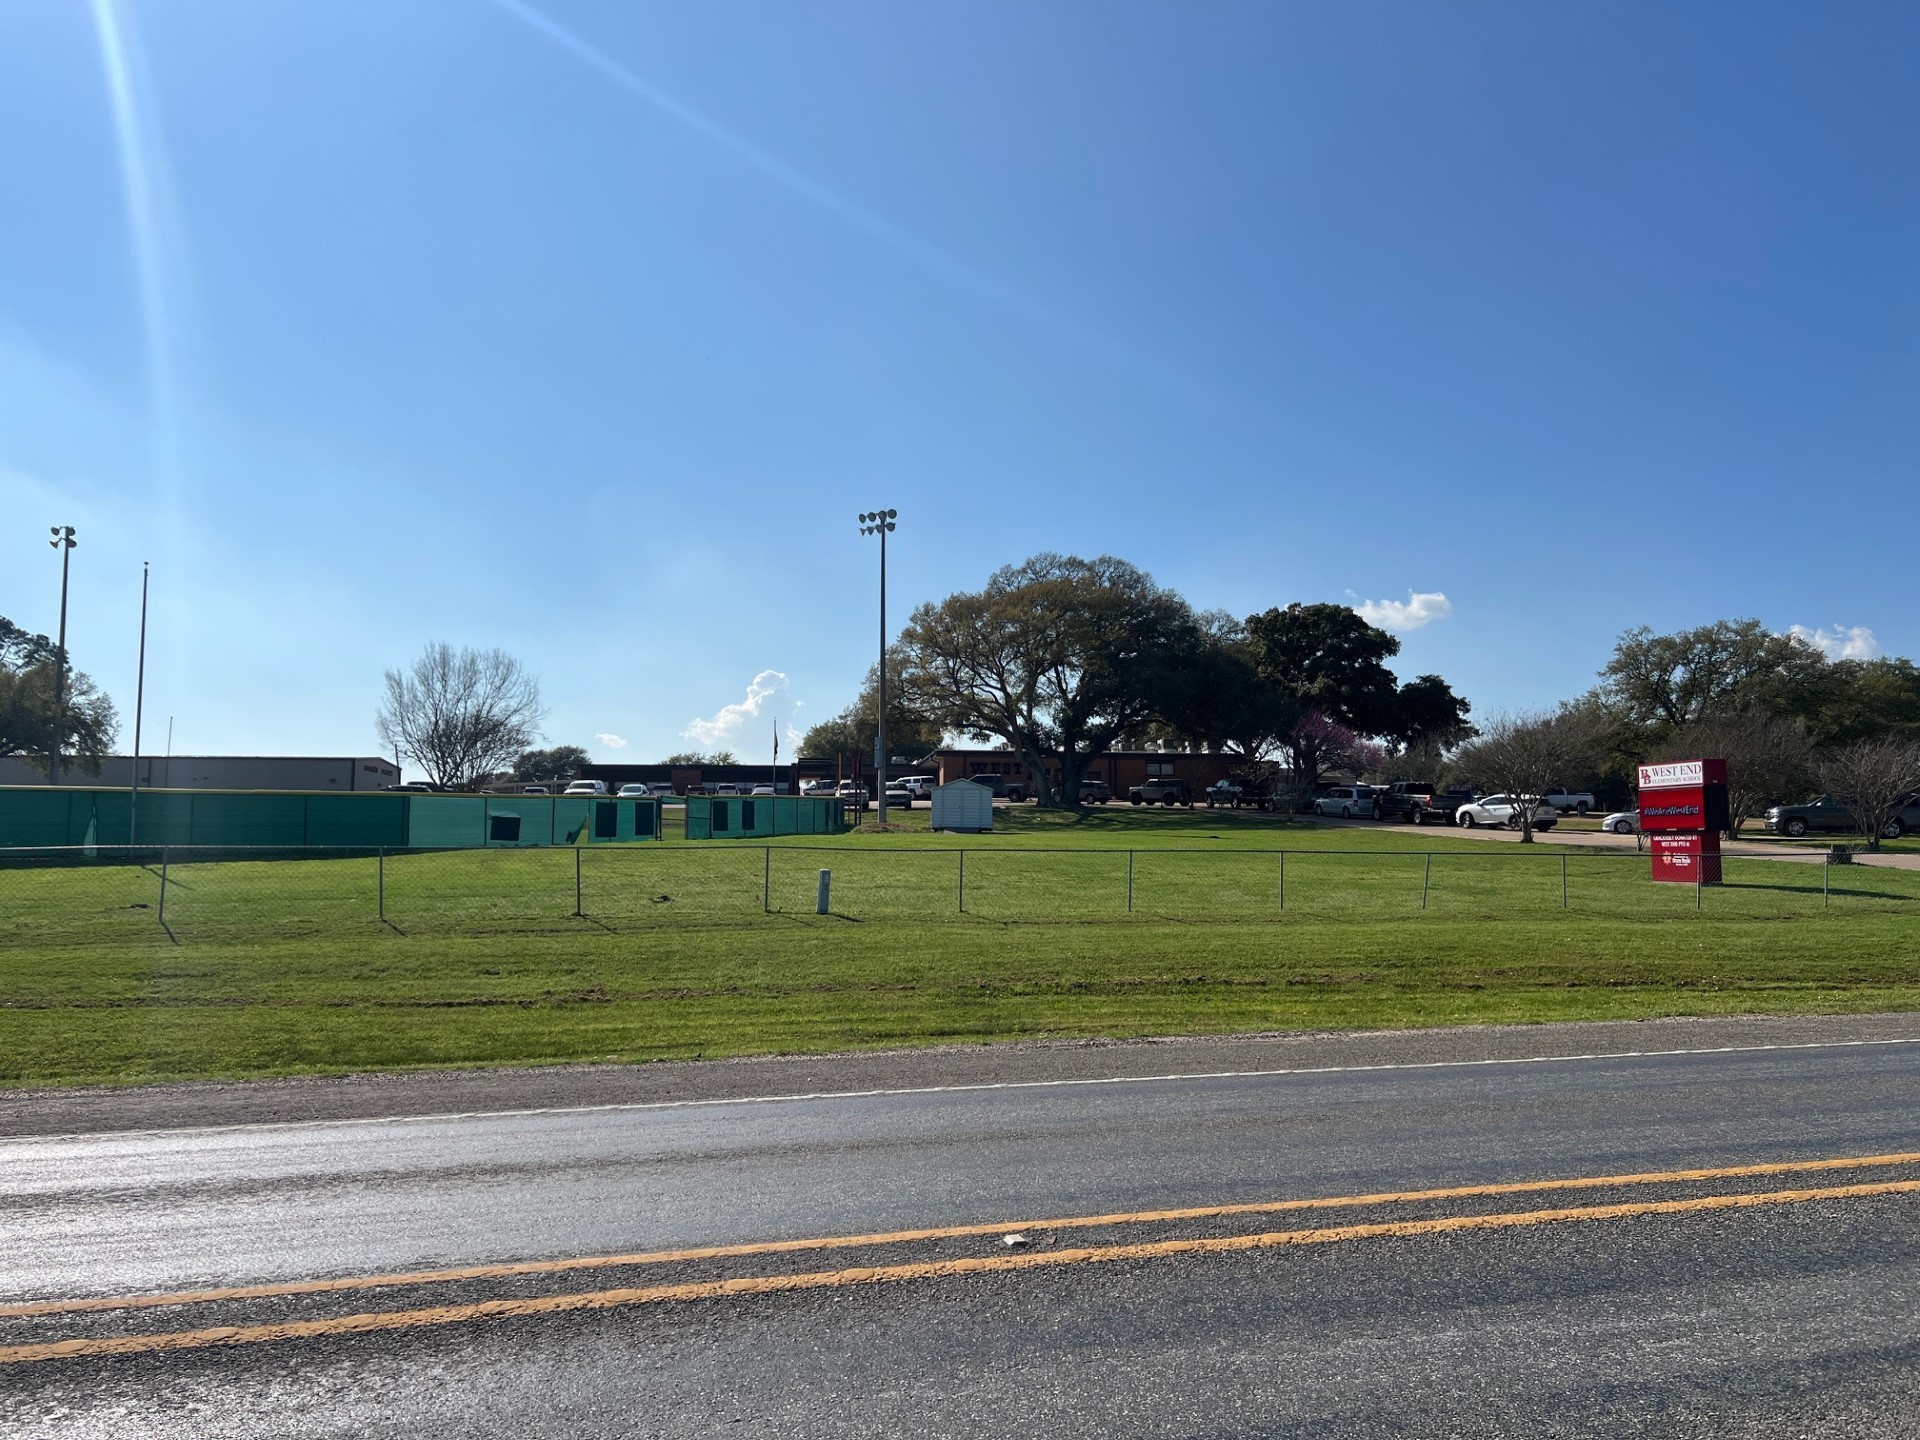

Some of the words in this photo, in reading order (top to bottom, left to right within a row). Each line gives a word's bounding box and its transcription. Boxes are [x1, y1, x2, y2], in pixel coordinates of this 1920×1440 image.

[970, 762, 1022, 775] WEST
[1652, 766, 1677, 777] WEST
[1680, 764, 1701, 775] END
